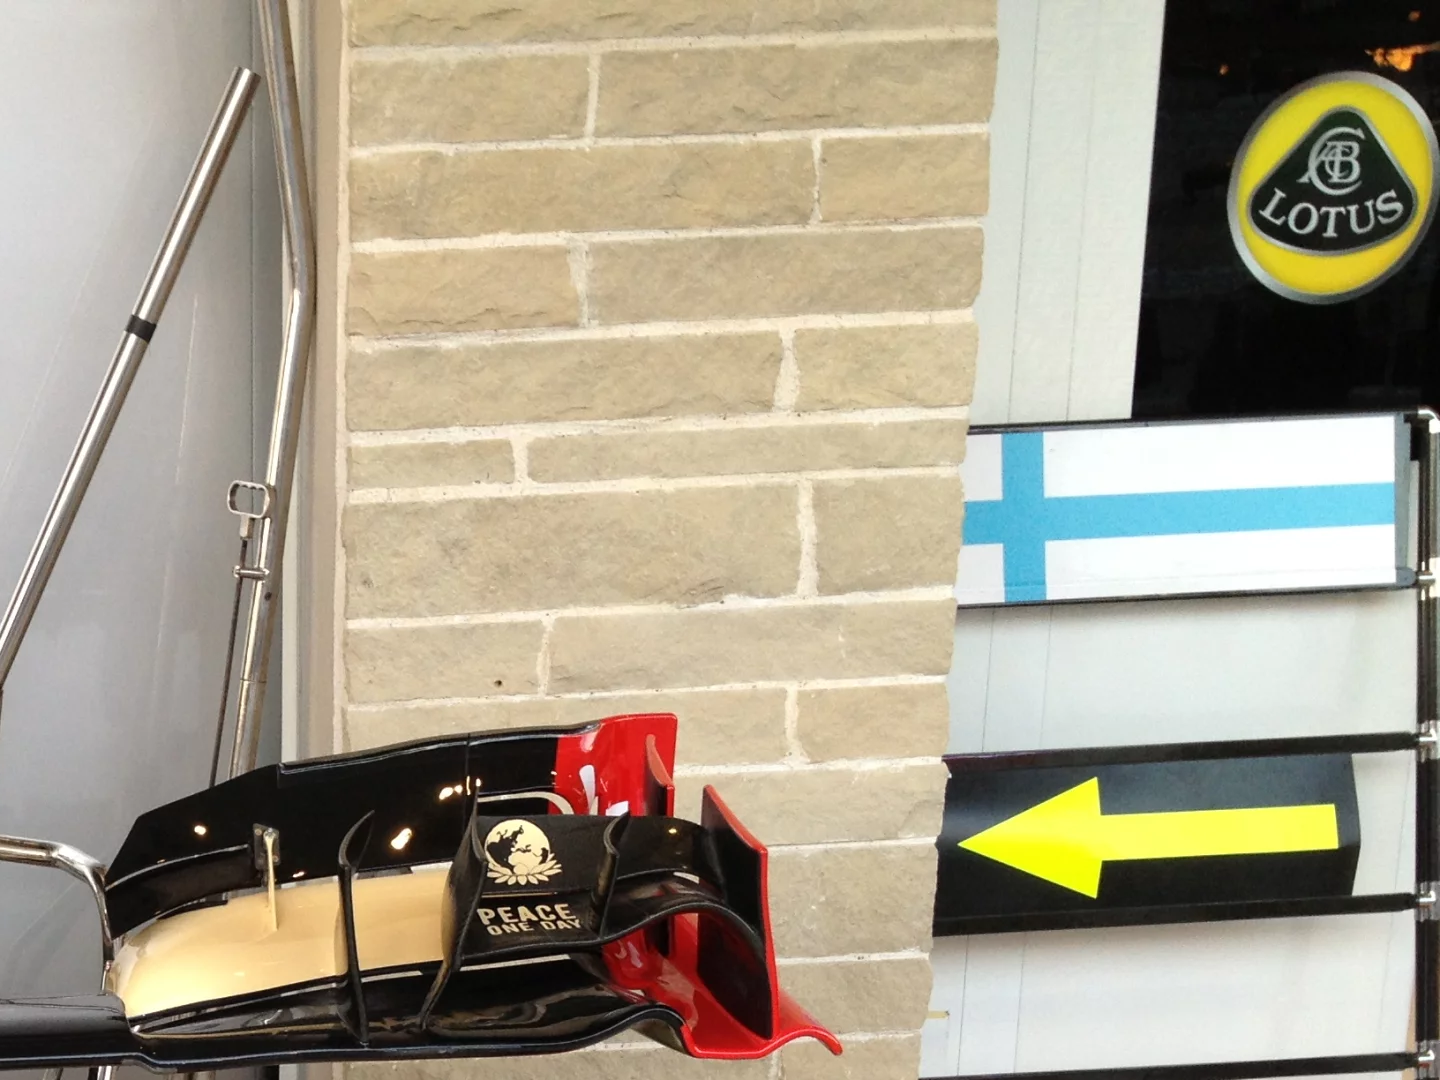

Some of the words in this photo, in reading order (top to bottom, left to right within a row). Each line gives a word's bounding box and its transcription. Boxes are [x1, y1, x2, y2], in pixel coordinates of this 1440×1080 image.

[1258, 187, 1404, 237] LOTUS
[476, 903, 577, 926] PEACE
[486, 922, 536, 936] ONE
[540, 919, 581, 930] DAY
